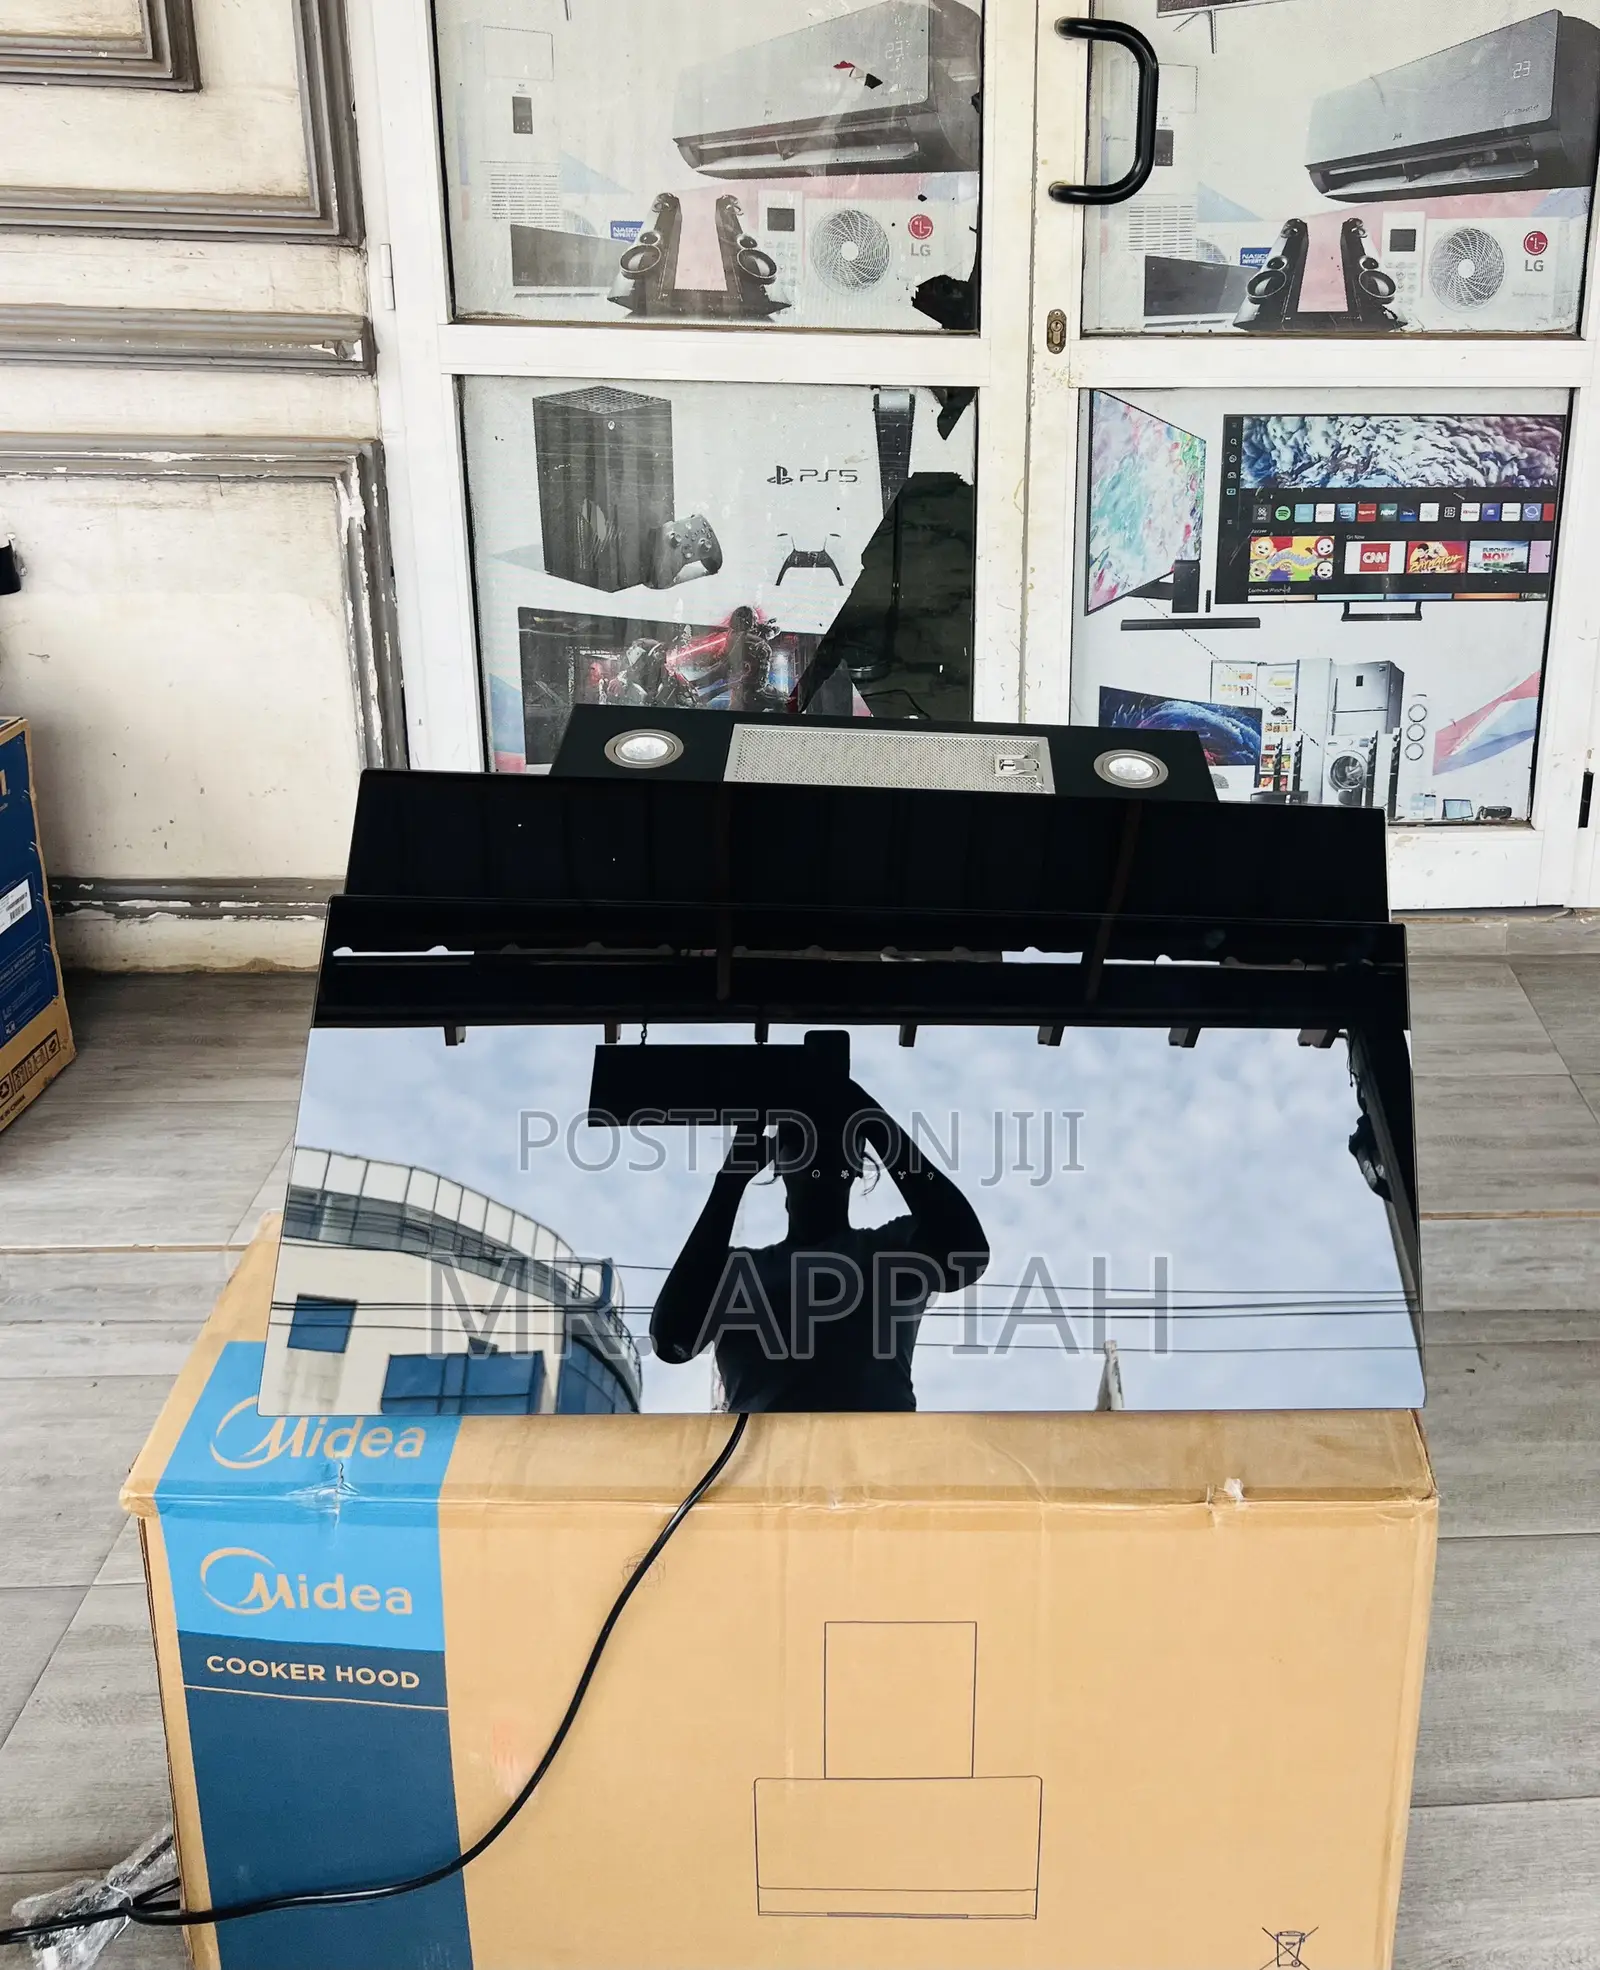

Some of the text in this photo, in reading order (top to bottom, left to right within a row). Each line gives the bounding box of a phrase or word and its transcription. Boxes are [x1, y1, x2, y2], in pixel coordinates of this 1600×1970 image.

[1513, 60, 1531, 79] 23
[910, 243, 931, 257] LG
[1524, 259, 1544, 272] LG
[799, 469, 858, 483] PS5
[1362, 551, 1387, 564] CNN
[210, 1395, 427, 1469] Midea
[201, 1547, 413, 1616] Midea
[206, 1655, 421, 1690] COOKER HOOD
